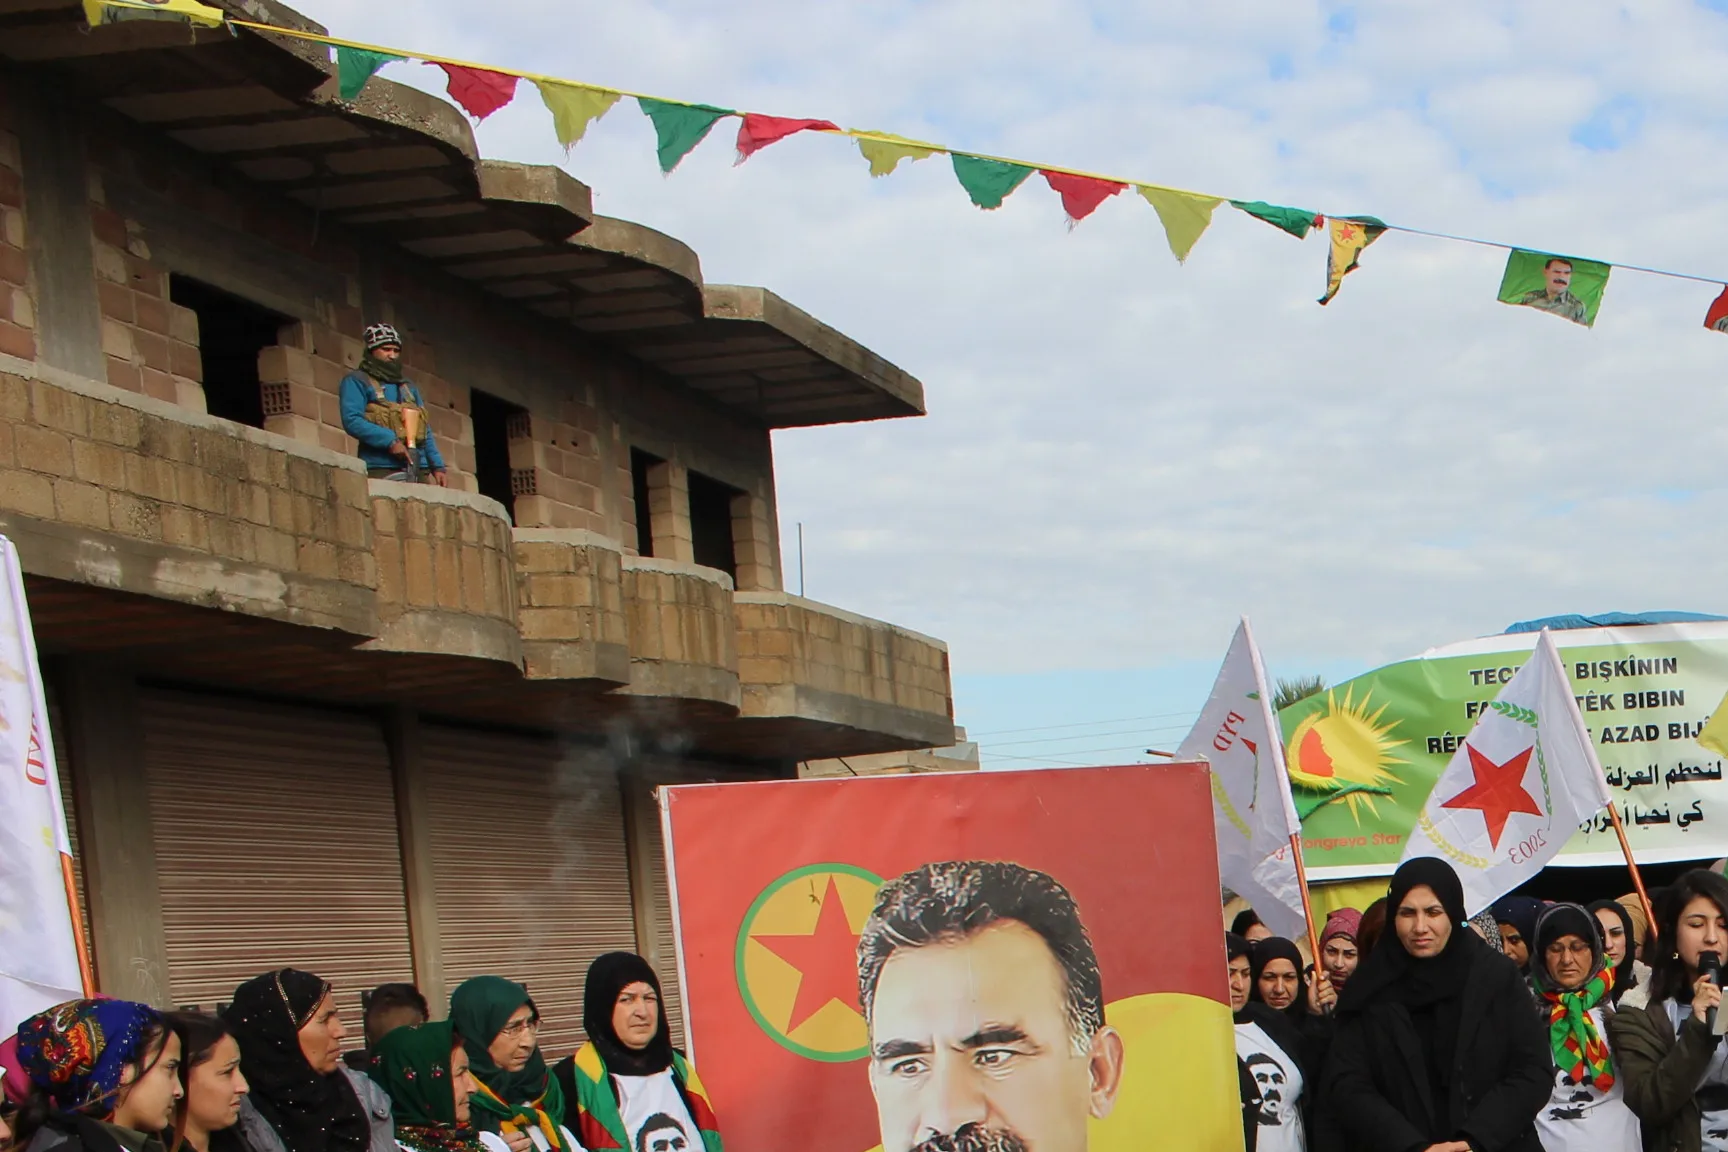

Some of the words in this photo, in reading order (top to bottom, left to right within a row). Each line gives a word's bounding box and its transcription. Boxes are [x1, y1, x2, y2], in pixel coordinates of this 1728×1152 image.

[1576, 654, 1678, 683] BIŞKÎNIN
[1623, 689, 1685, 710] BIBIN
[1600, 724, 1660, 745] AZAD
[1606, 763, 1659, 791] العزلة
[1665, 760, 1722, 790] لنحطم
[1633, 801, 1671, 831] نحيا
[1676, 799, 1704, 832] كي
[1301, 836, 1367, 851] ongreya
